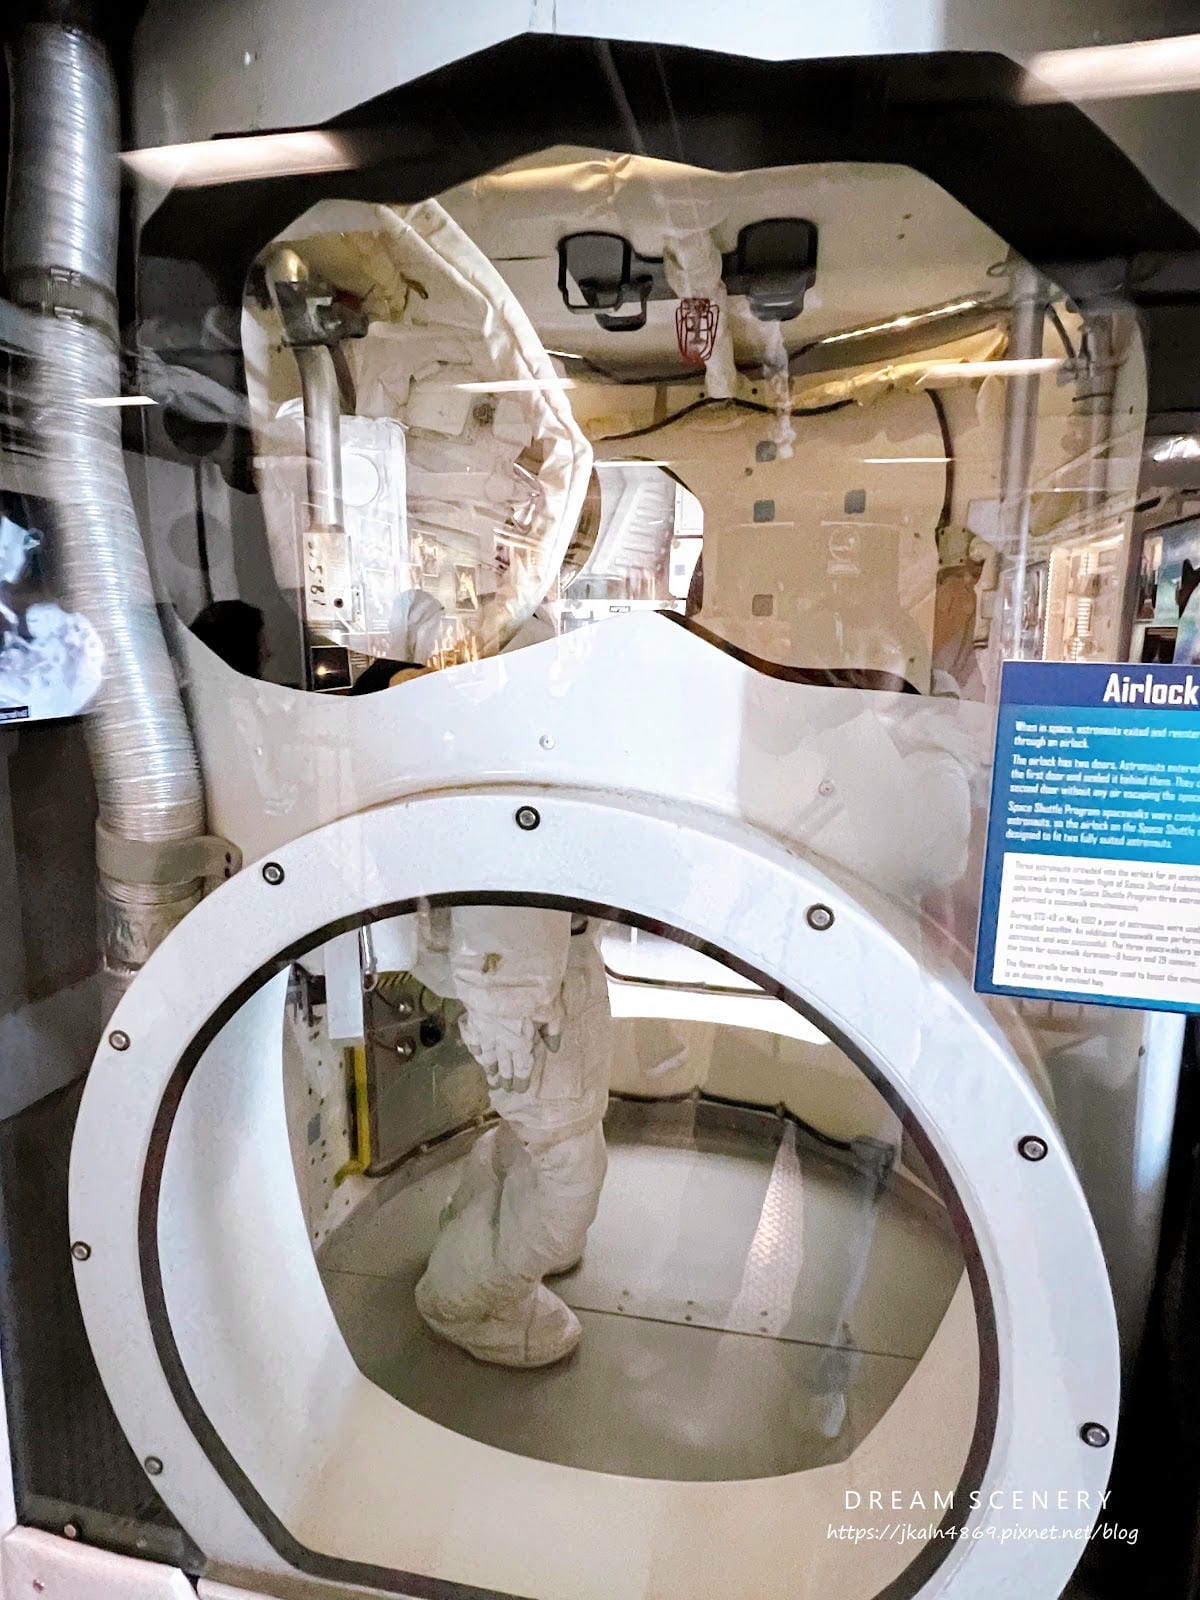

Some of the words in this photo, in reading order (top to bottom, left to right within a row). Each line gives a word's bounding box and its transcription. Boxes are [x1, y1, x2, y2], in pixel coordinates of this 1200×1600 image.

[1103, 672, 1200, 705] Airlock
[1013, 754, 1027, 765] The
[1008, 801, 1032, 814] Space
